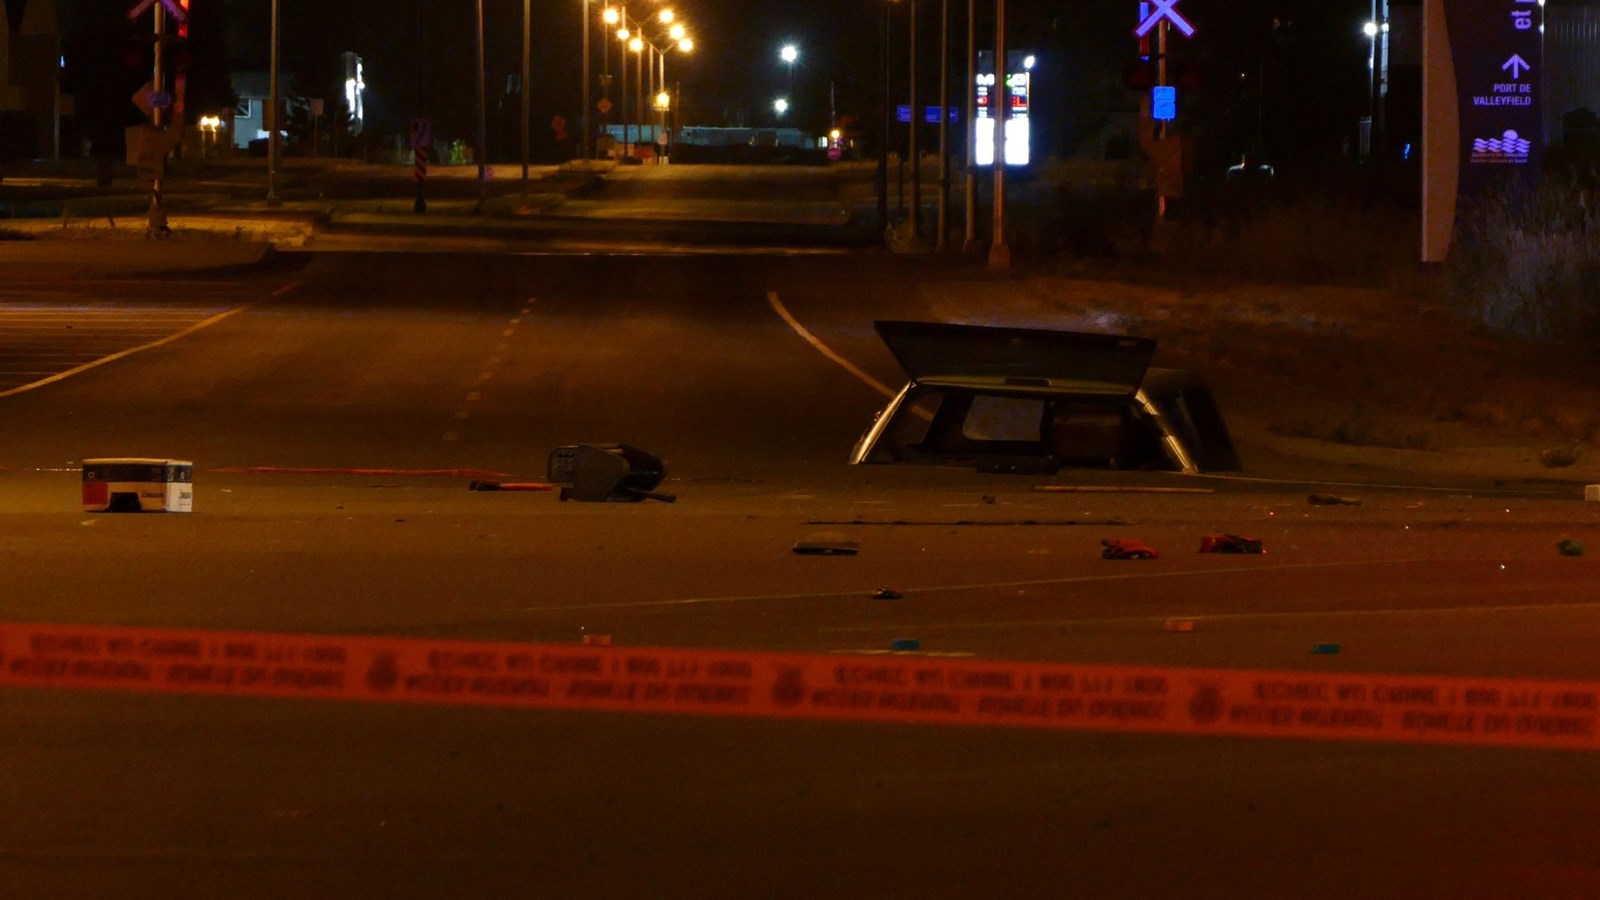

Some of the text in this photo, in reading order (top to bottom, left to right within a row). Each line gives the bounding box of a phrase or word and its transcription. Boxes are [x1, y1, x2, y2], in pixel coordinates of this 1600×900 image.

[1511, 10, 1532, 29] et
[1493, 83, 1532, 93] PORT DE
[1473, 96, 1531, 106] VALLEYFIELD
